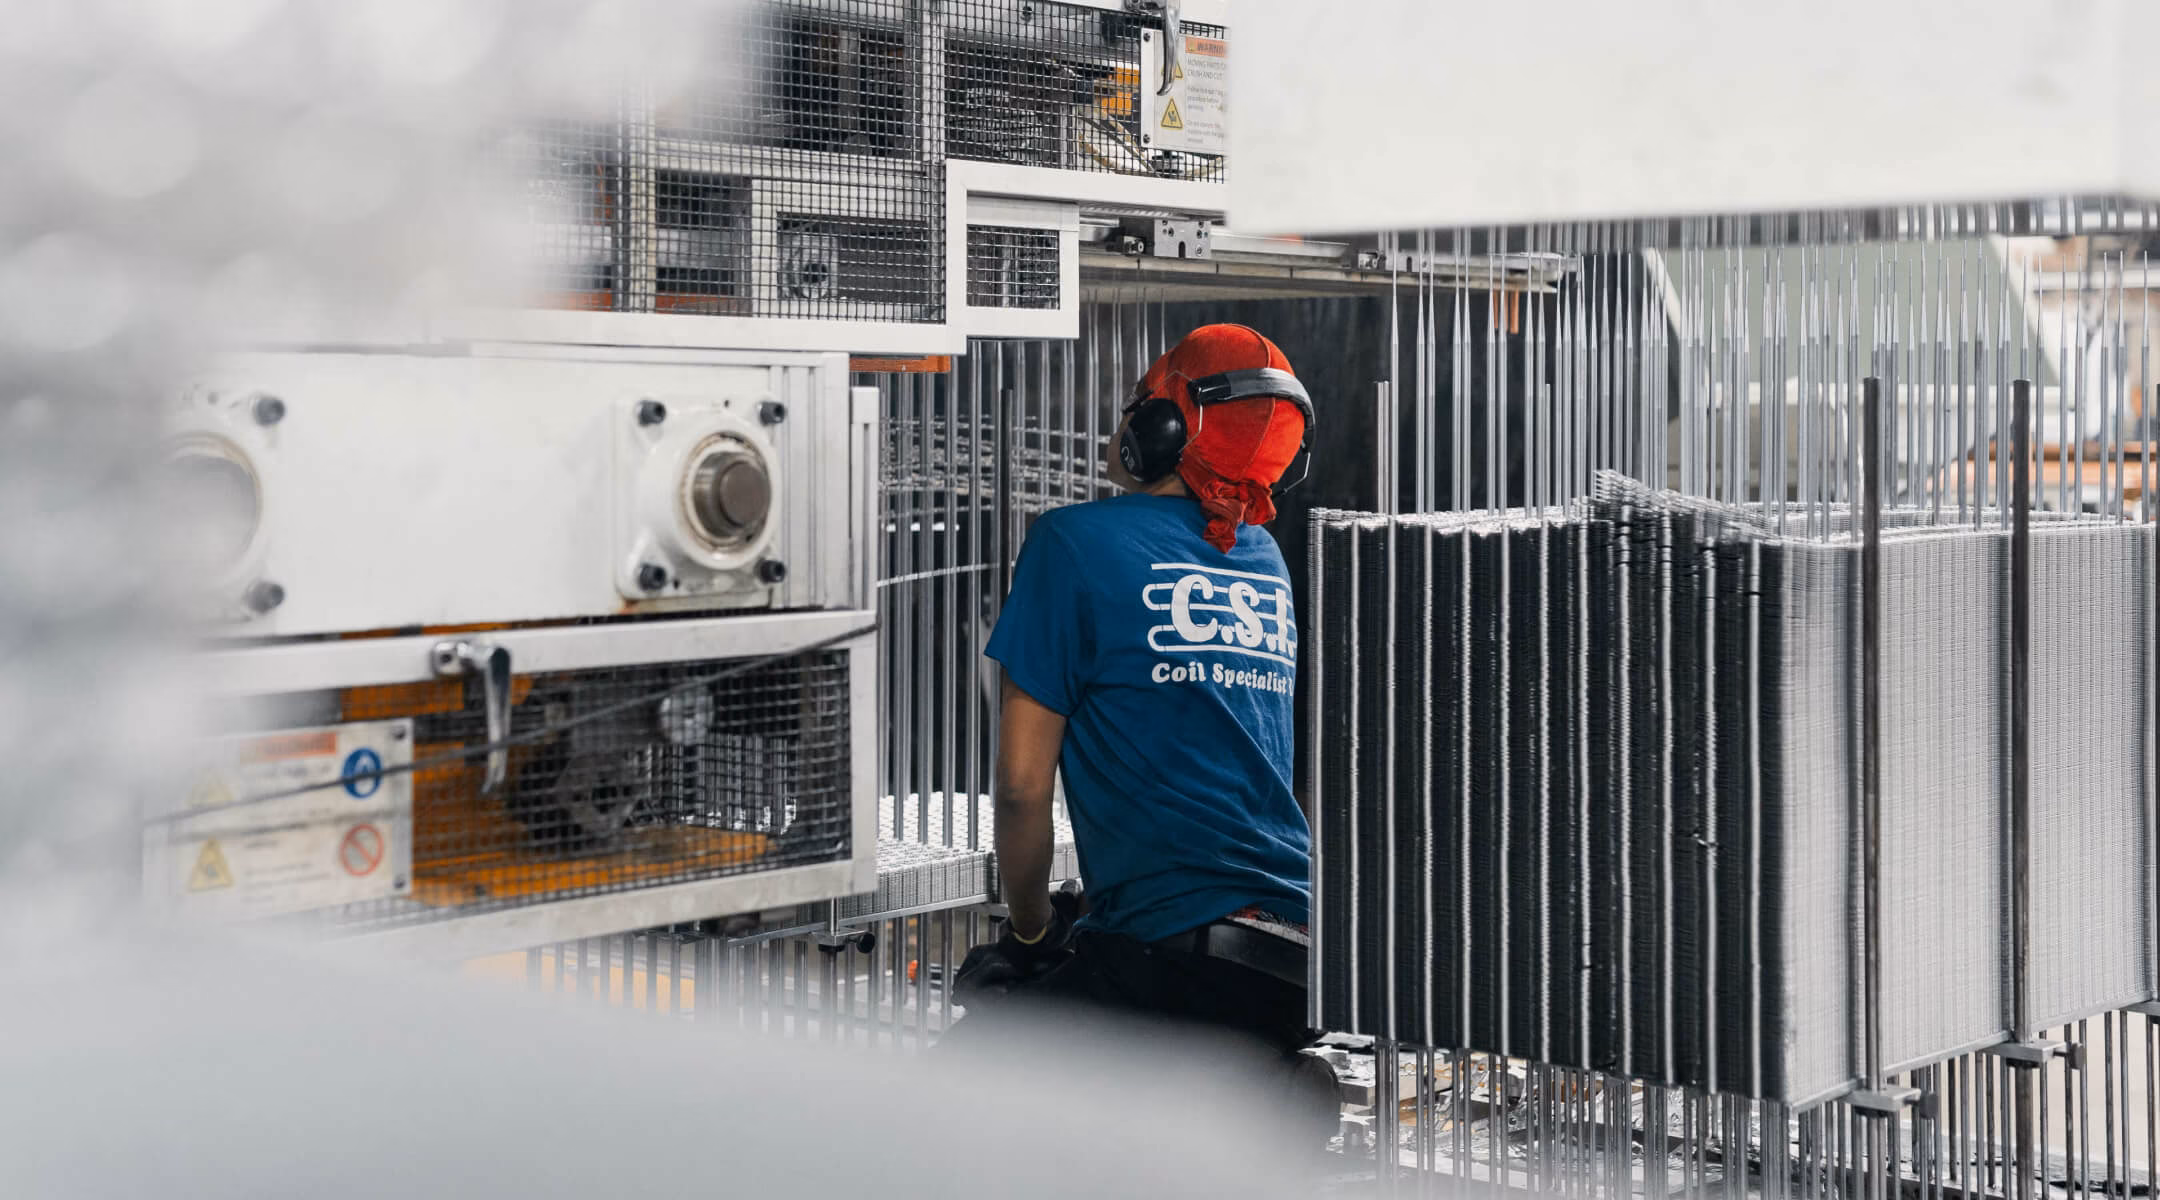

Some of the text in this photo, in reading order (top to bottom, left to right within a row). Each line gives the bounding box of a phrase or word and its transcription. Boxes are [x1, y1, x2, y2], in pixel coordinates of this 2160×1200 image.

[1197, 42, 1226, 55] WARNIN
[1171, 573, 1295, 658] C.S.I.
[1151, 661, 1206, 683] Coil
[1212, 663, 1287, 694] Specialist
